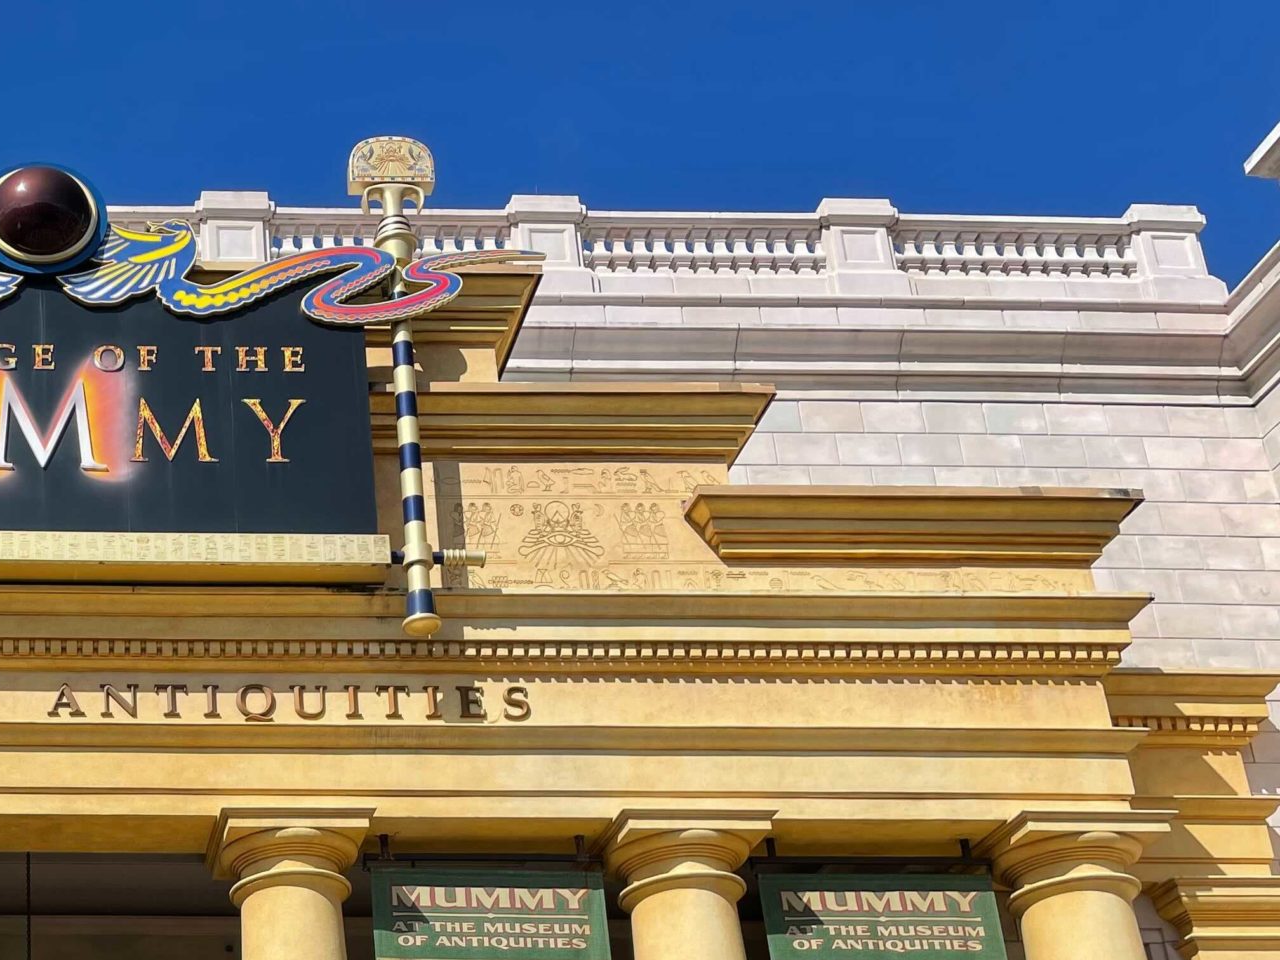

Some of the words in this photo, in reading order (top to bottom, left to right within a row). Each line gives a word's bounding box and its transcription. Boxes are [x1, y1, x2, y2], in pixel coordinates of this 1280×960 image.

[93, 344, 159, 372] OF
[194, 345, 306, 372] THE
[47, 682, 533, 723] ANTIQUITIES
[391, 886, 589, 910] MUMMY
[780, 891, 978, 913] MUMMY
[392, 921, 423, 932] AT
[429, 921, 477, 933] THE
[483, 922, 591, 935] MUSEUM
[786, 925, 817, 936] AT
[823, 925, 871, 936] THE
[877, 926, 986, 937] MUSEUM
[397, 935, 429, 947] OF
[435, 936, 587, 950] ANTIQUITIES
[792, 939, 825, 950] OF
[831, 939, 983, 953] ANTIQUITIES
